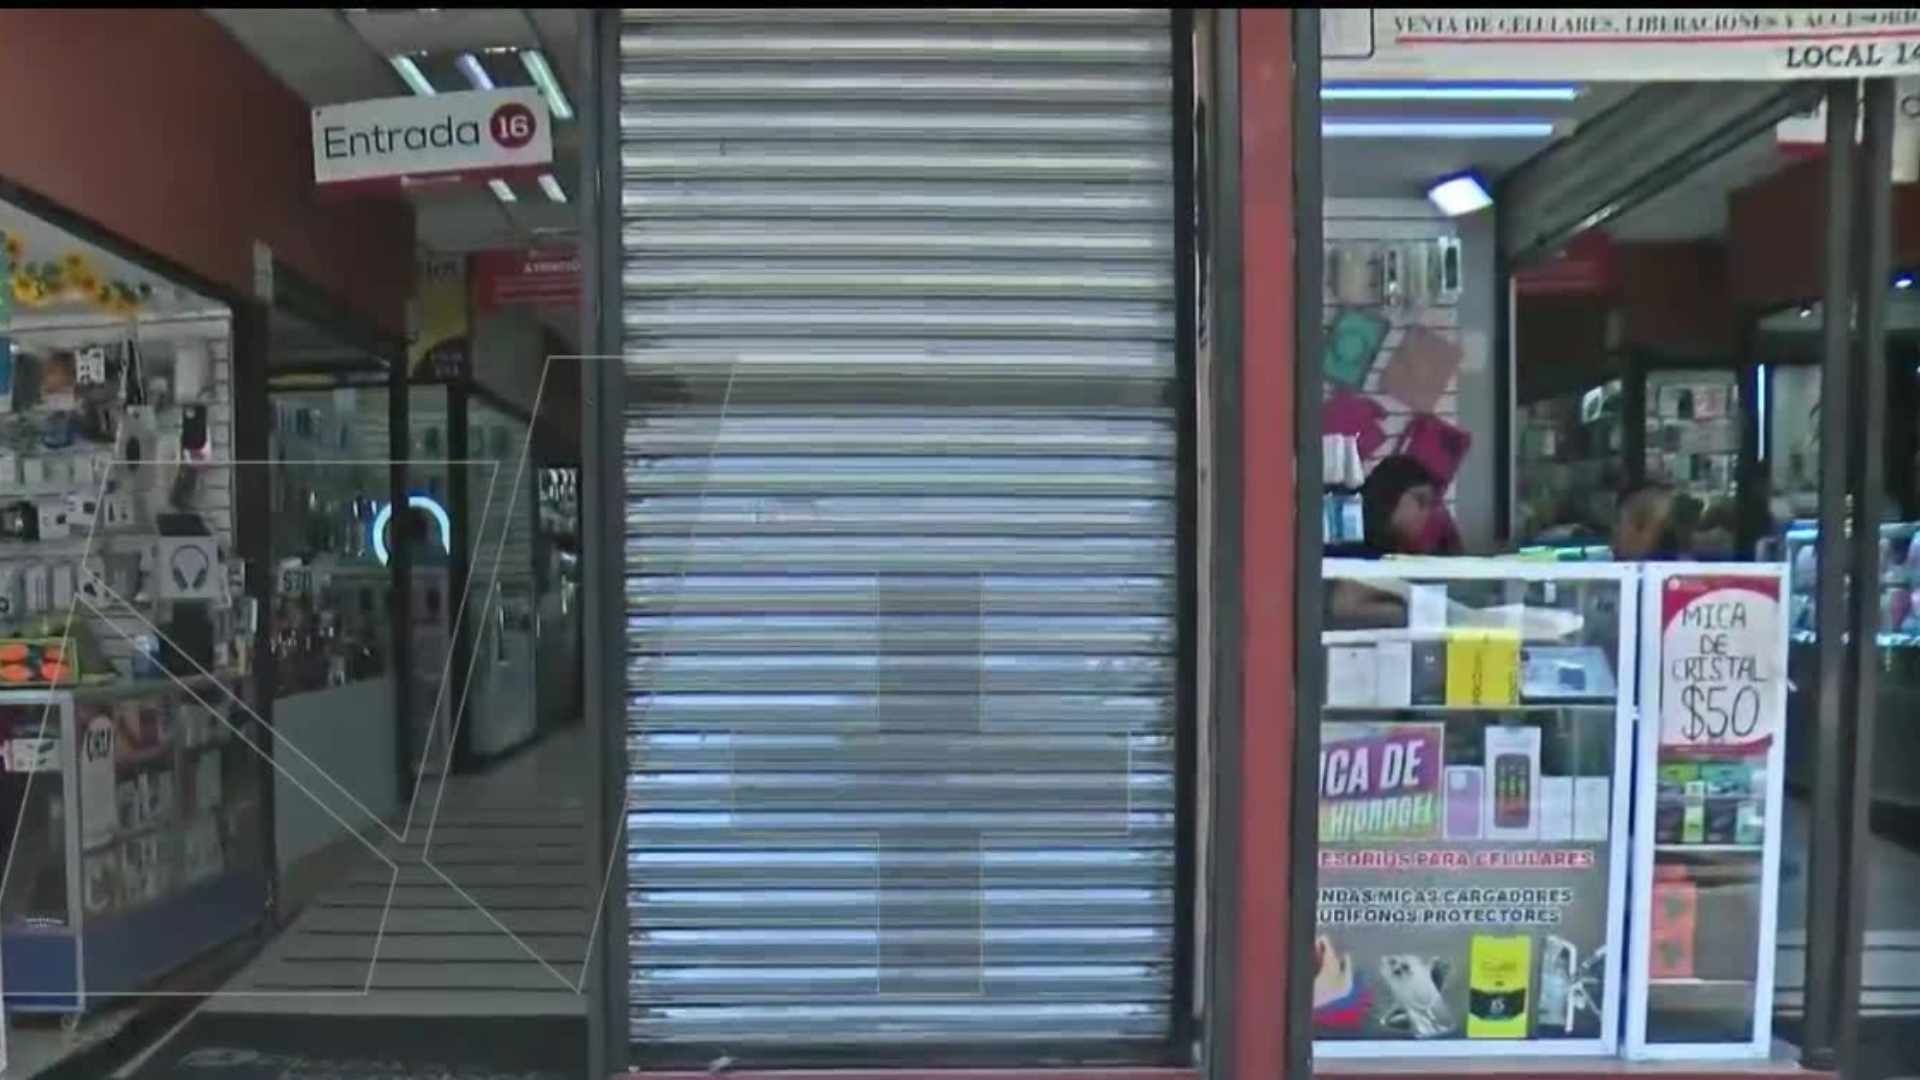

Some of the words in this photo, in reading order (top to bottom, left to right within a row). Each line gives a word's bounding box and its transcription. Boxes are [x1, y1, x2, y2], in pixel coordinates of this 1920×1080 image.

[1395, 16, 1457, 33] VENTA
[1466, 16, 1494, 33] DE
[1786, 43, 1884, 68] LOCAL
[324, 115, 480, 159] Entrada
[498, 115, 530, 138] 16
[1682, 603, 1746, 628] MICA
[1700, 633, 1728, 655] DE
[1671, 656, 1768, 682] CRISTAL
[1681, 685, 1760, 740] $50
[1380, 739, 1425, 789] DE
[1417, 852, 1468, 866] PARA
[1474, 852, 1593, 866] CELULARES
[1378, 889, 1438, 903] MICAS
[1444, 889, 1571, 903] CARGADORES
[1320, 909, 1417, 923] UDIFONOS
[1423, 909, 1559, 923] PROTECTORES
